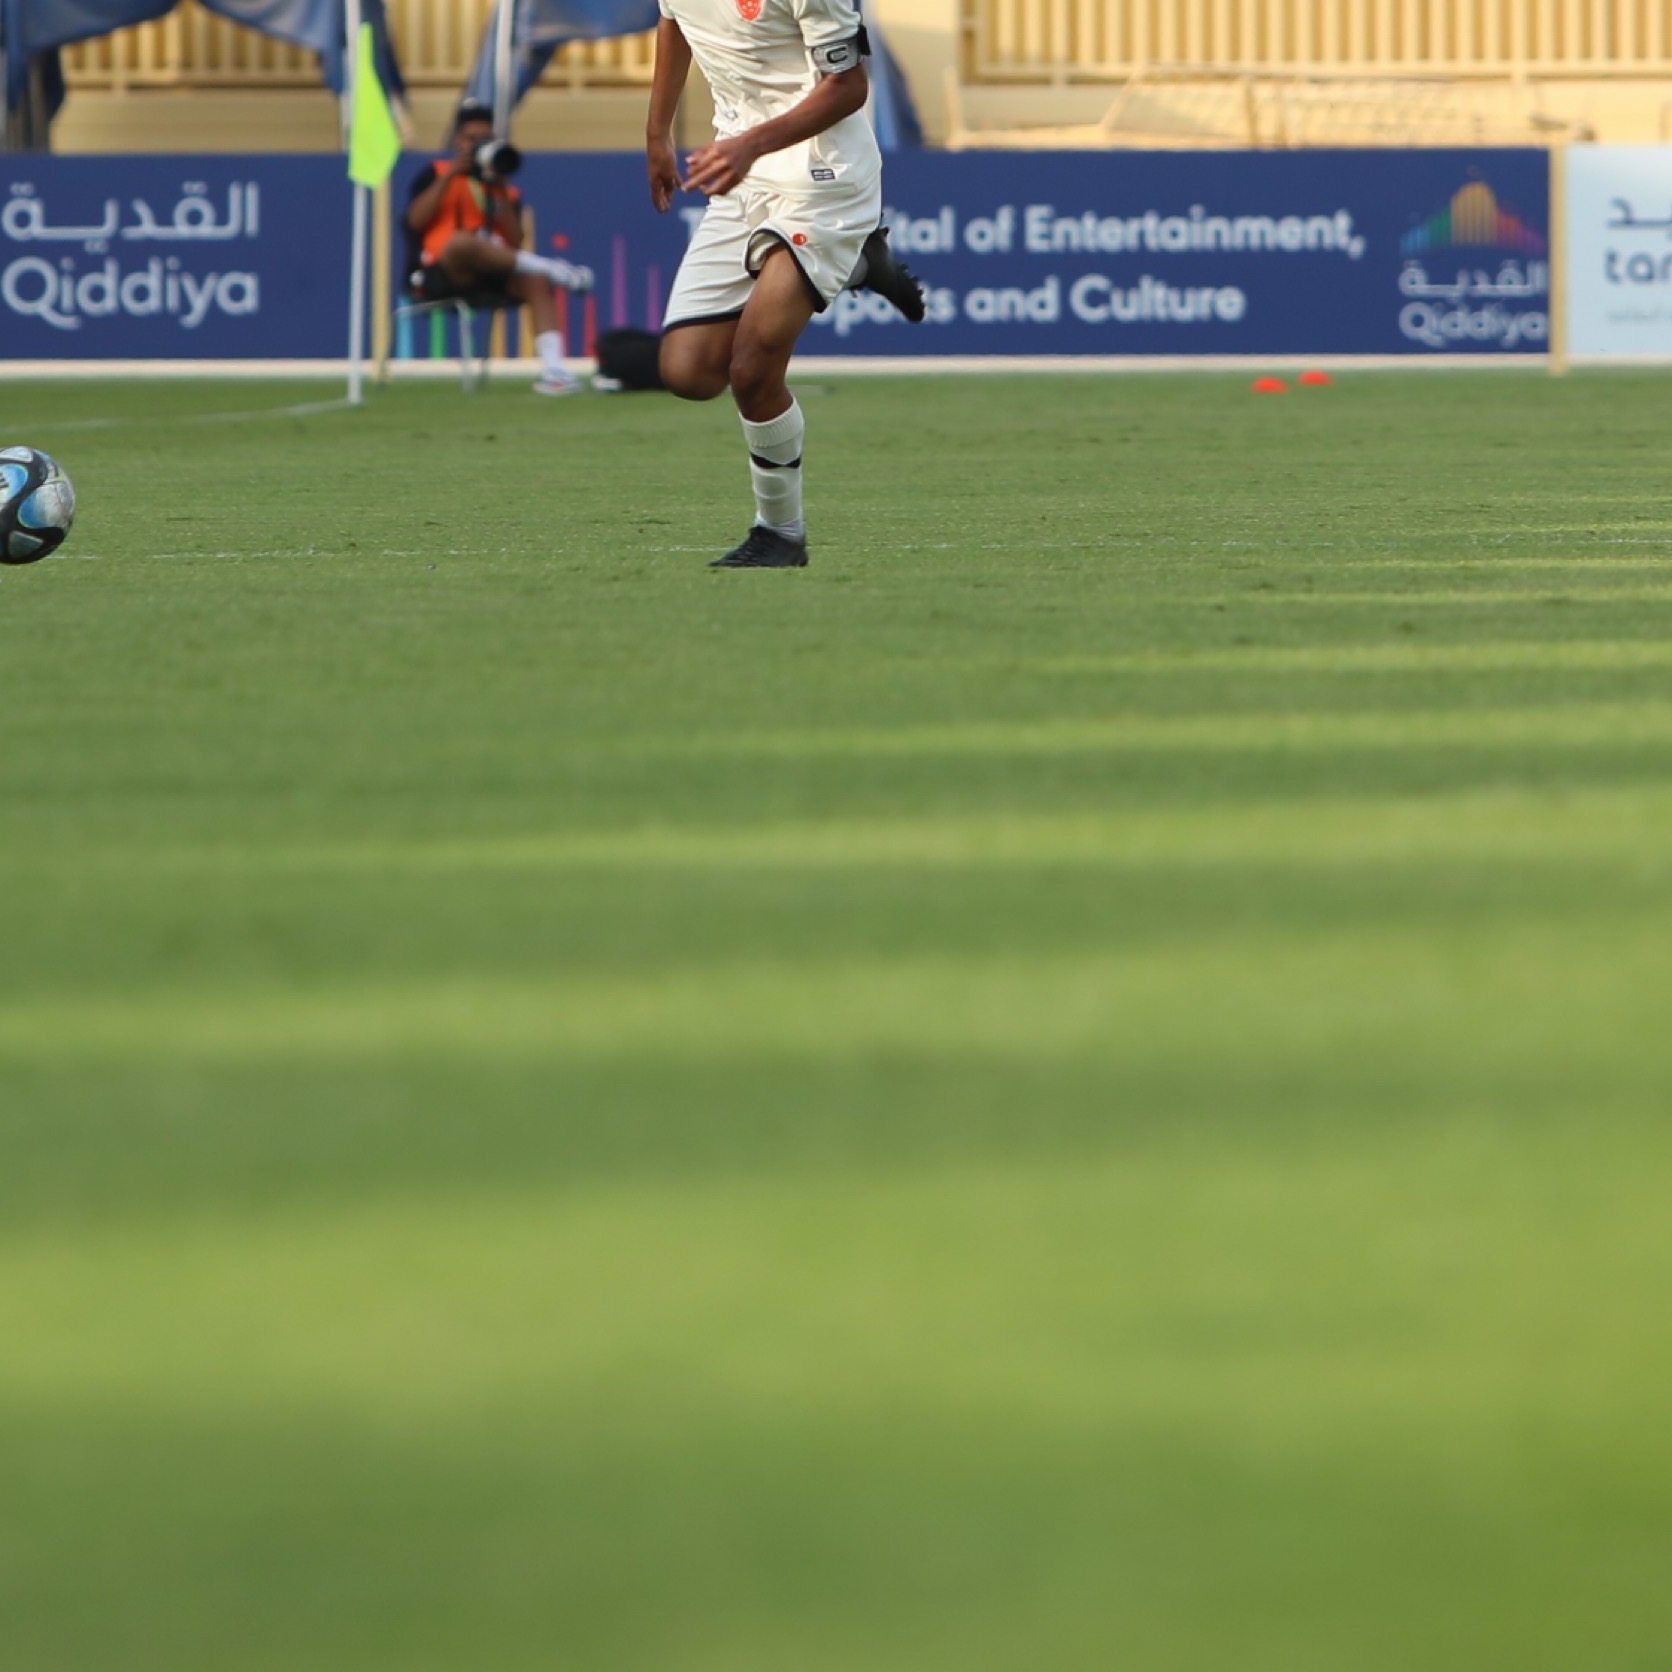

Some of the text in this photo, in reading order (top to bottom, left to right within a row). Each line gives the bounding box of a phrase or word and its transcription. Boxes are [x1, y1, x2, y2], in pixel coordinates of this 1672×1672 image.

[964, 204, 1016, 253] of
[1025, 204, 1366, 259] Entertainment,
[0, 256, 260, 329] Qiddiya
[964, 275, 1060, 323] and
[1070, 274, 1246, 323] Culture
[1398, 301, 1548, 349] Qiddiya
